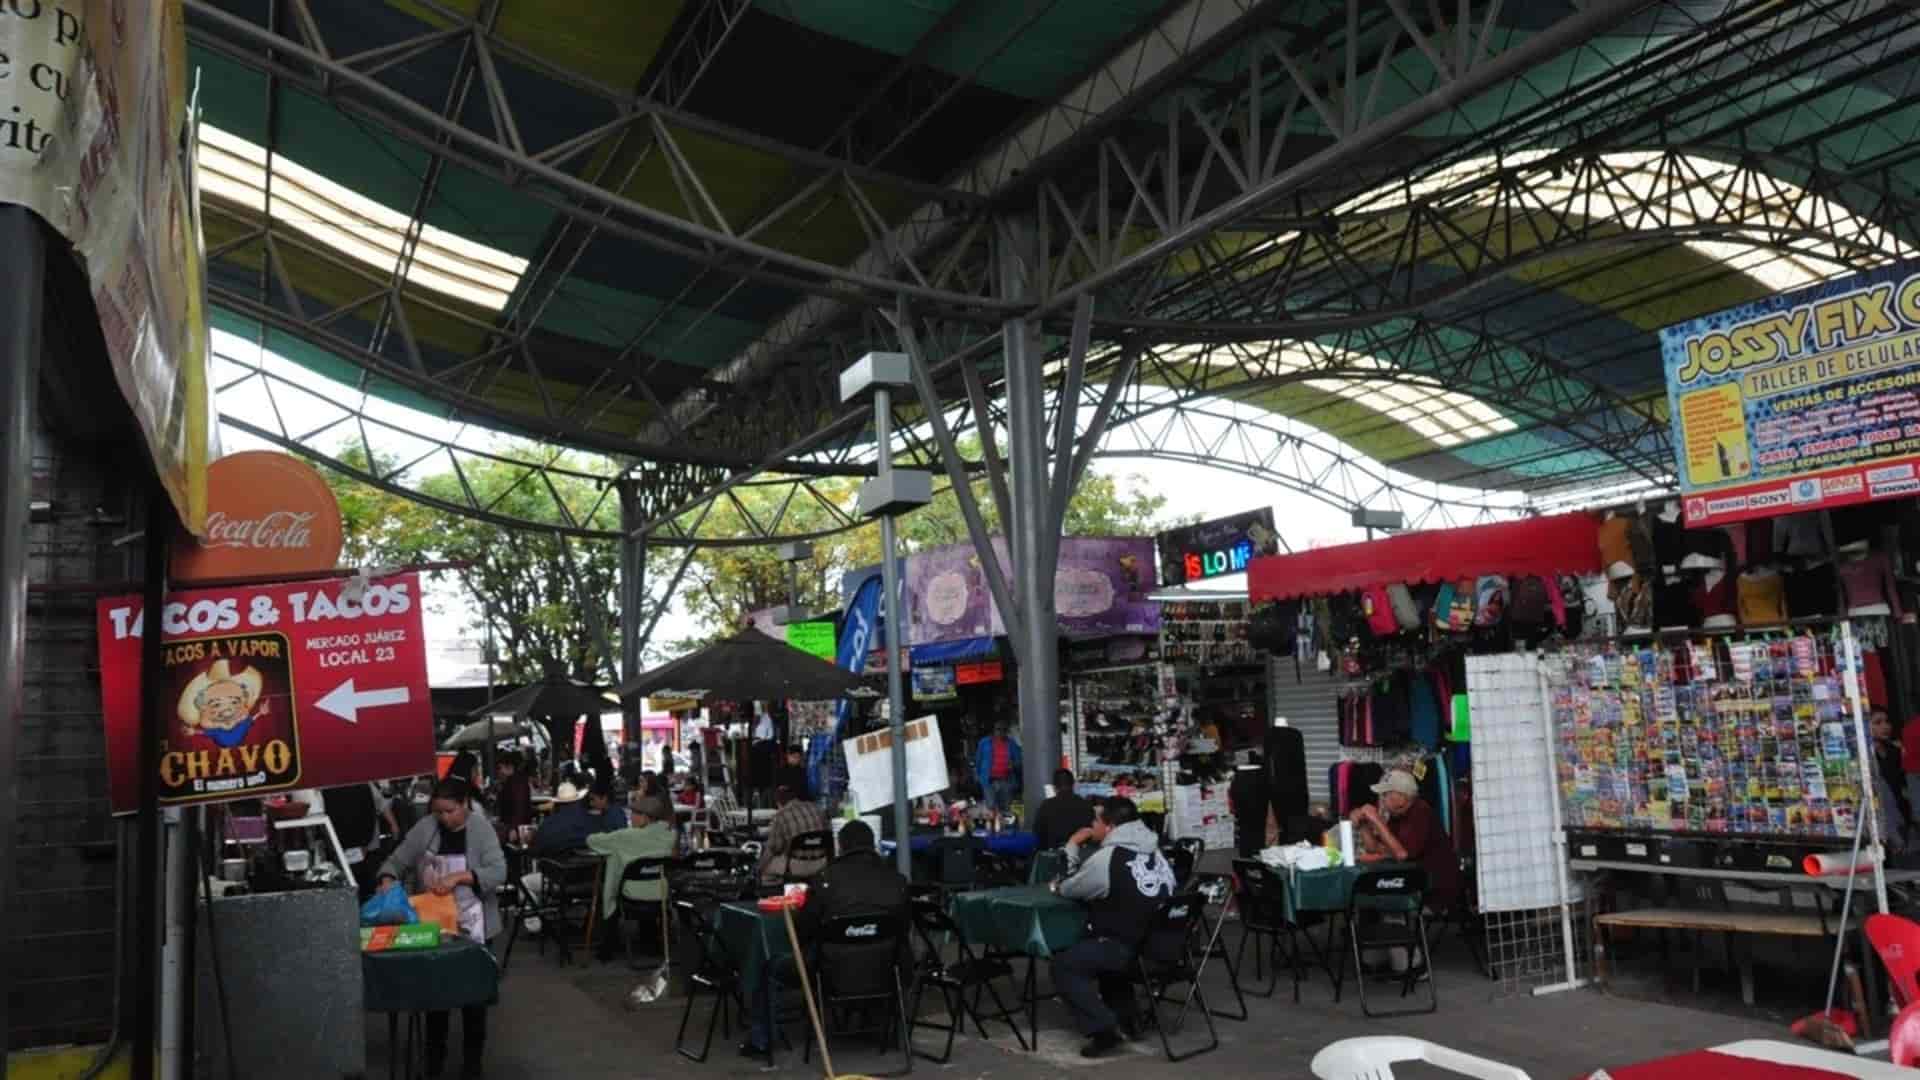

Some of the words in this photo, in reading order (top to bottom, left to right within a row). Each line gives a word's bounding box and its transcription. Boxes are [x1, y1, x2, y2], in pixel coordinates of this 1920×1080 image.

[1679, 308, 1810, 384] JOSSY
[1814, 287, 1894, 349] FIX
[1751, 366, 1808, 393] TALLER
[1817, 359, 1836, 377] DE
[1826, 388, 1844, 400] DE
[1750, 491, 1789, 506] SONY
[249, 595, 280, 627] &
[288, 583, 411, 624] TACOS
[211, 642, 222, 657] A
[226, 639, 281, 658] VAPOR
[306, 636, 361, 651] MERCADO
[364, 629, 407, 644] JUÁREZ
[320, 650, 370, 668] LOCAL
[375, 647, 396, 662] 23
[160, 739, 291, 788] CHAVO
